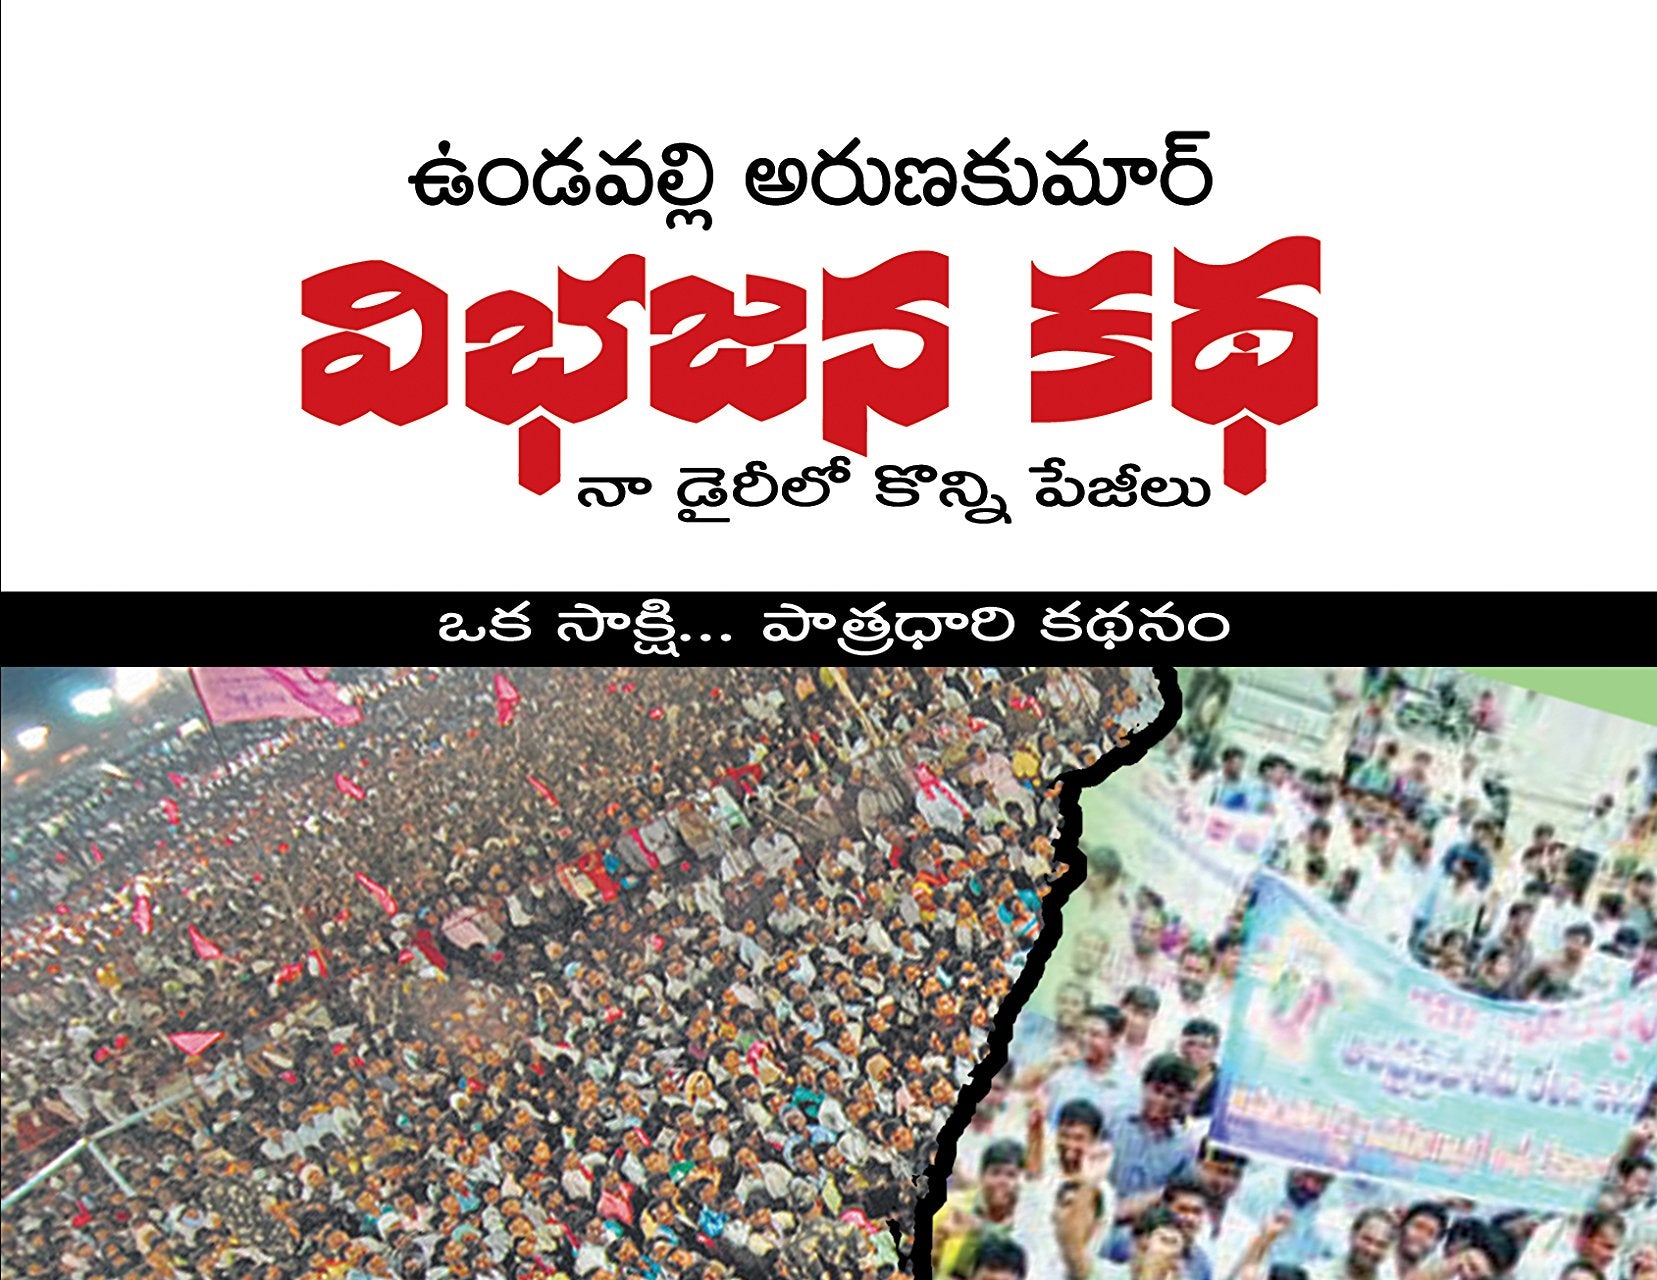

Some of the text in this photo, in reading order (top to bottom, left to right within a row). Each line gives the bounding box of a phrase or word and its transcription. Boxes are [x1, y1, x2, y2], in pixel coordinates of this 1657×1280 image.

[408, 131, 1212, 230] ఉండవల్లి అరుణకుమార్
[302, 236, 1320, 495] విభజన కథ
[578, 456, 1210, 524] నా డైరీలో కొన్ని పేజీలు
[439, 601, 531, 641] ఒక
[763, 601, 1014, 655] పాత్రధారి
[1041, 601, 1229, 649] కథనం
